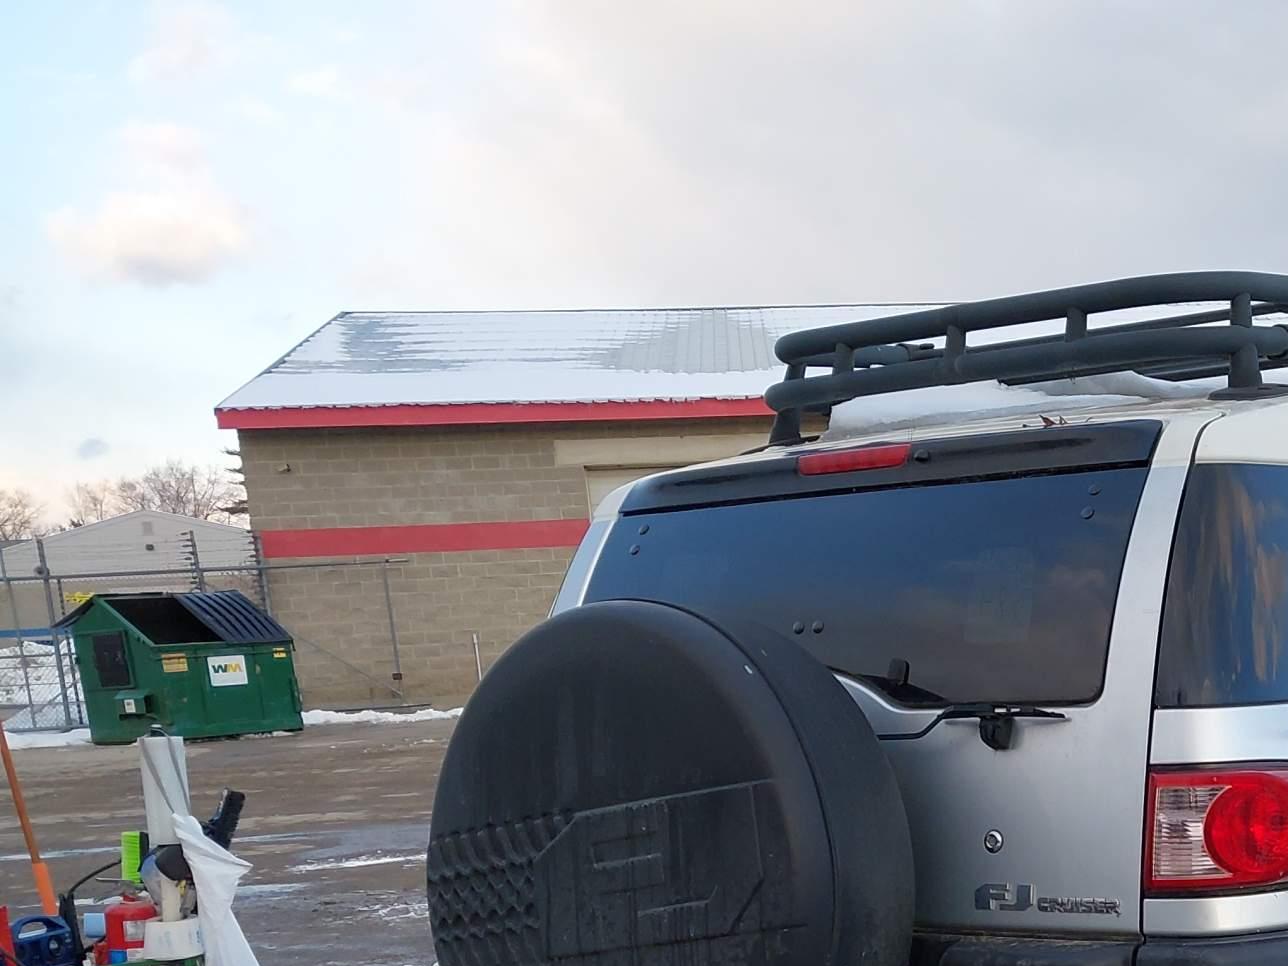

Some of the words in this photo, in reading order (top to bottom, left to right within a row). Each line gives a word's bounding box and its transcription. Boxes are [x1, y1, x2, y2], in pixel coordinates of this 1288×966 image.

[211, 663, 243, 673] WM
[974, 883, 1034, 911] FJ
[1037, 896, 1120, 917] CRUISER
